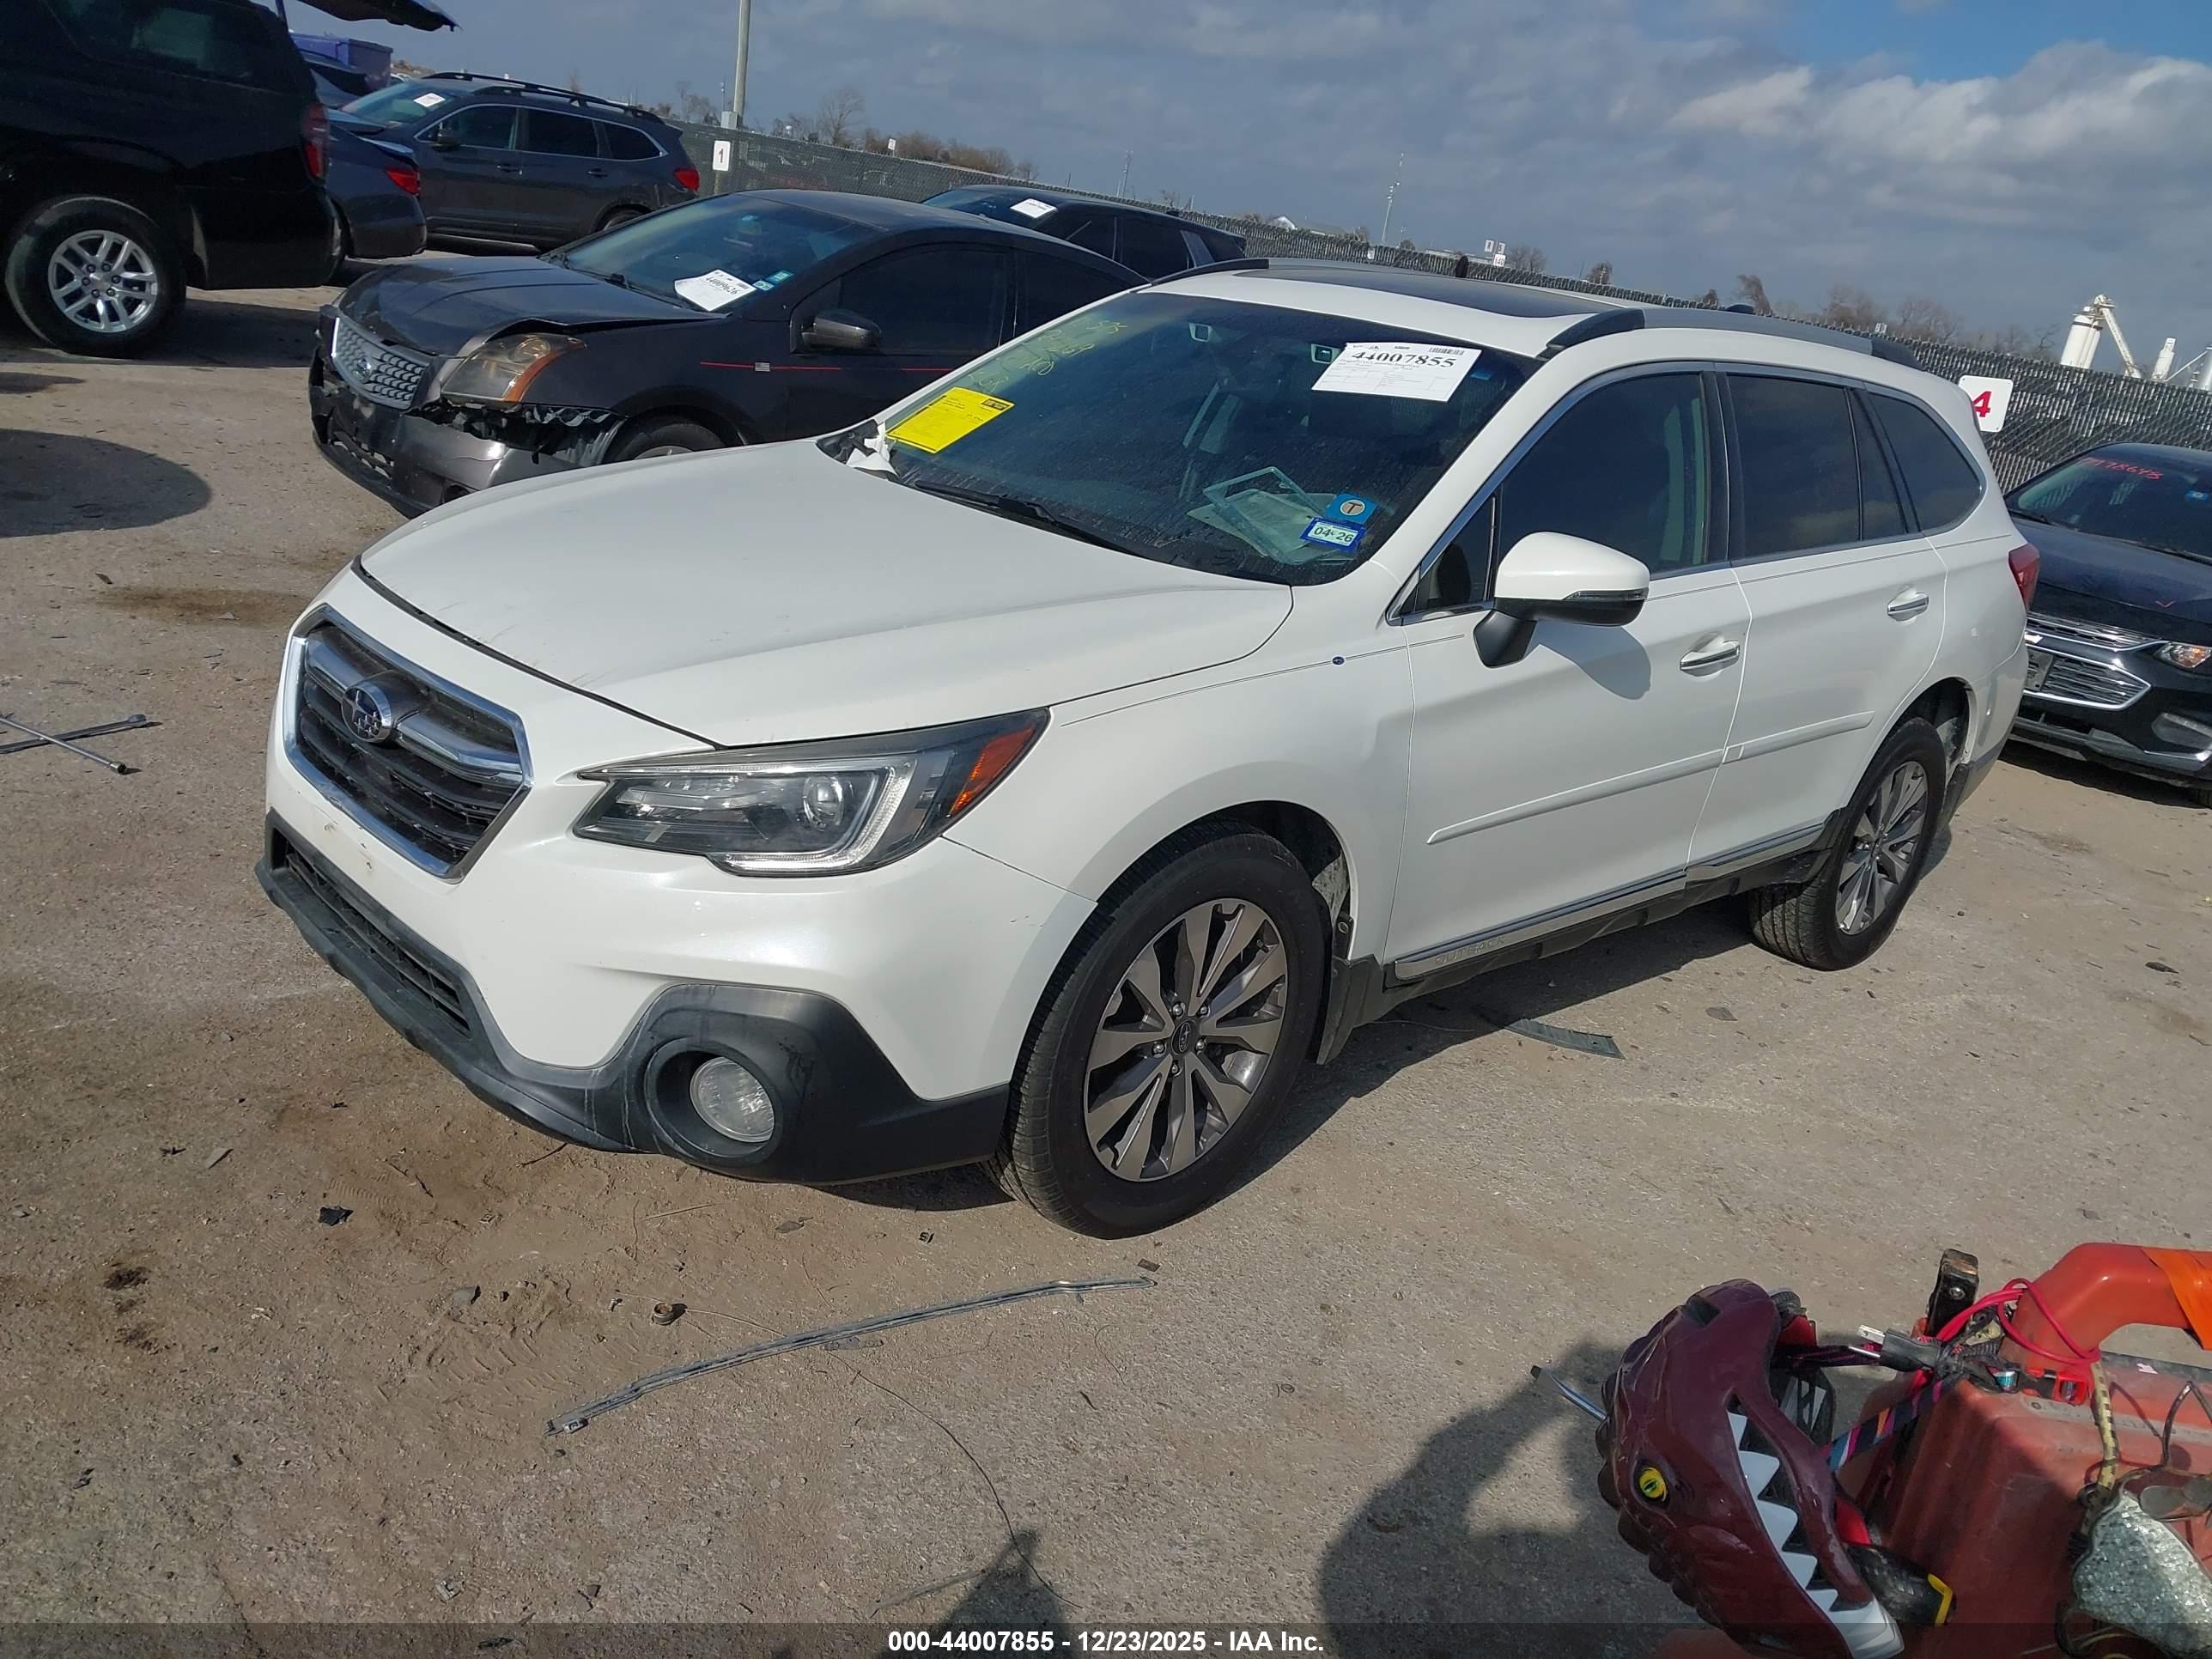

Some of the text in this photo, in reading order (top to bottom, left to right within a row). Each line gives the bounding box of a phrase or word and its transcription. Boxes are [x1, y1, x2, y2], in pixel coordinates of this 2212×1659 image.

[718, 148, 724, 164] 1
[1352, 351, 1457, 368] 44007855
[1972, 391, 1992, 418] 4
[1346, 501, 1362, 514] T
